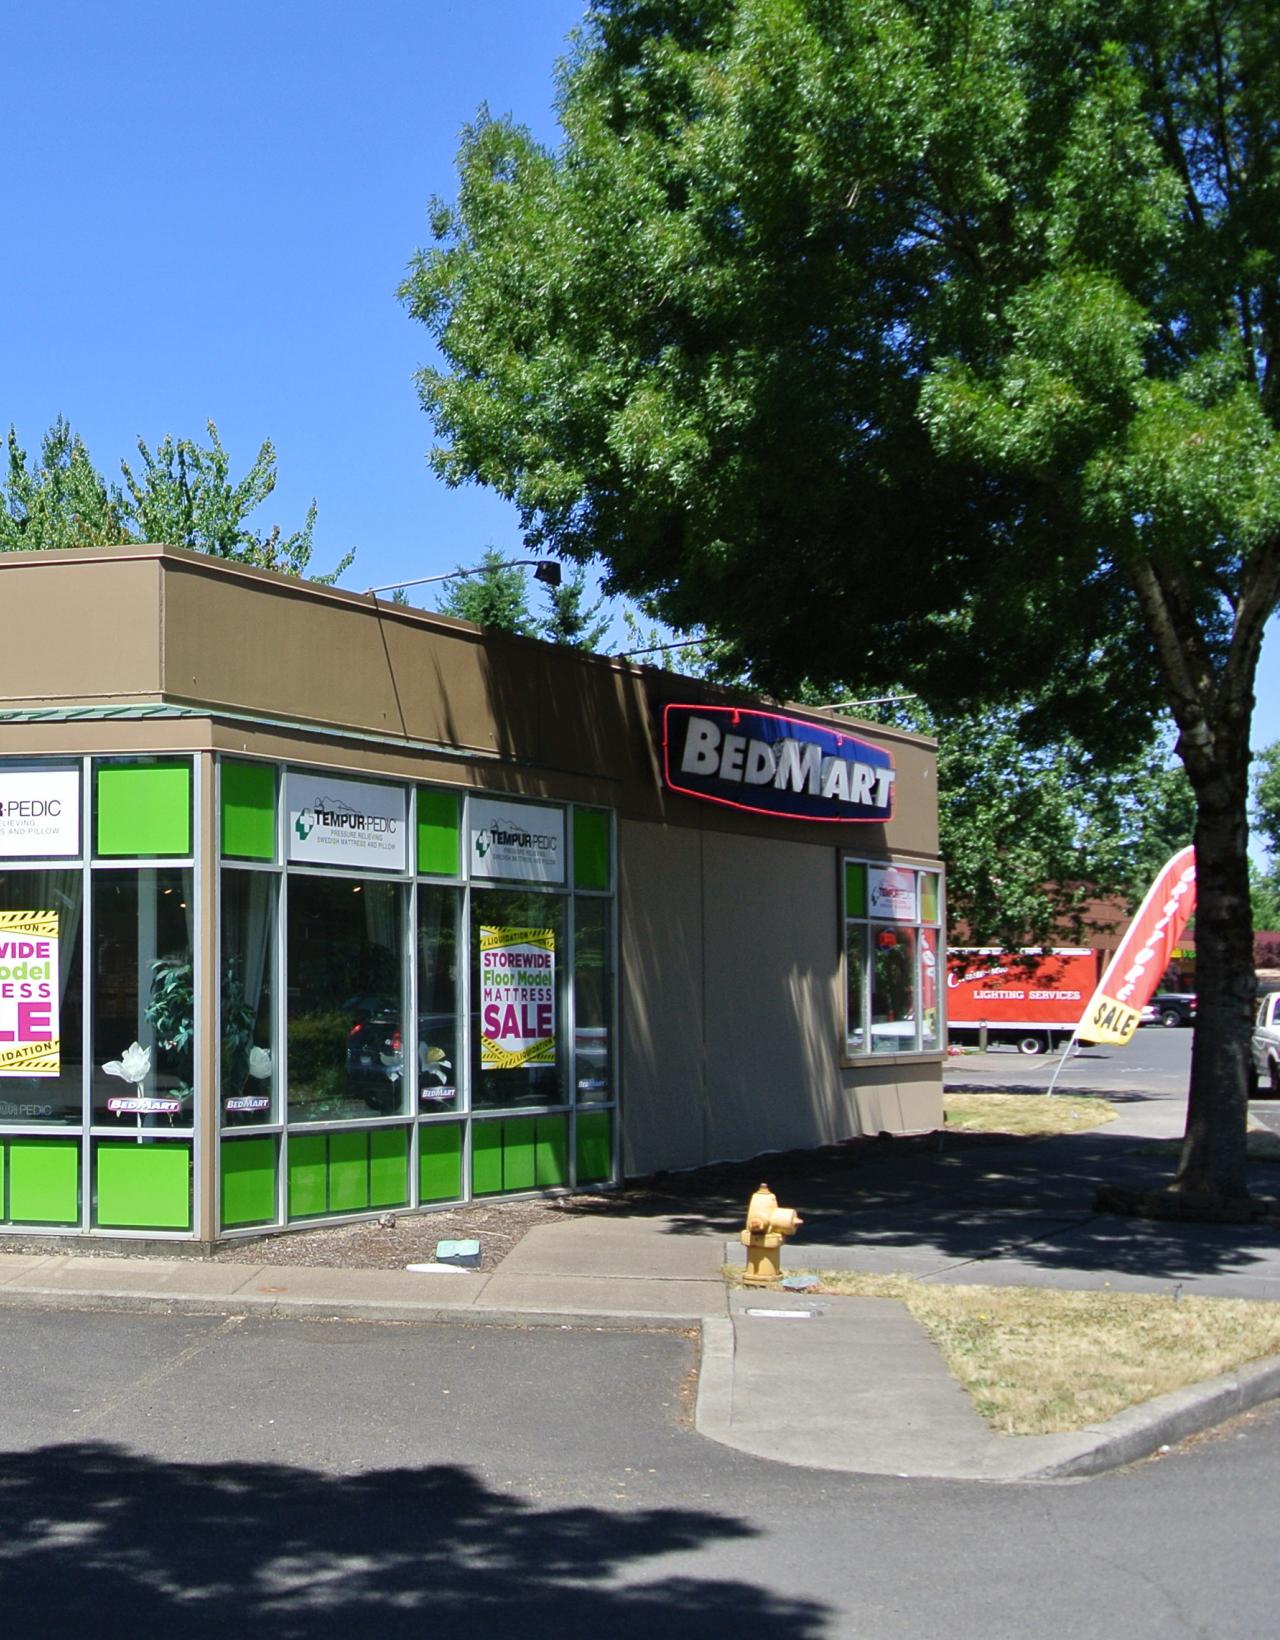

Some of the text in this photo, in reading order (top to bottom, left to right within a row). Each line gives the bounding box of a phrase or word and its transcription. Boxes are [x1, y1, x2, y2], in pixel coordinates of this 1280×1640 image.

[28, 827, 60, 835] PILLOW
[484, 952, 551, 968] STOREWIDE
[484, 970, 552, 986] Floor Model
[484, 988, 552, 1001] MATTRESS
[973, 990, 1081, 1000] LIGHTING SERVICES
[483, 1003, 553, 1040] SALE
[1093, 1001, 1137, 1037] SALE
